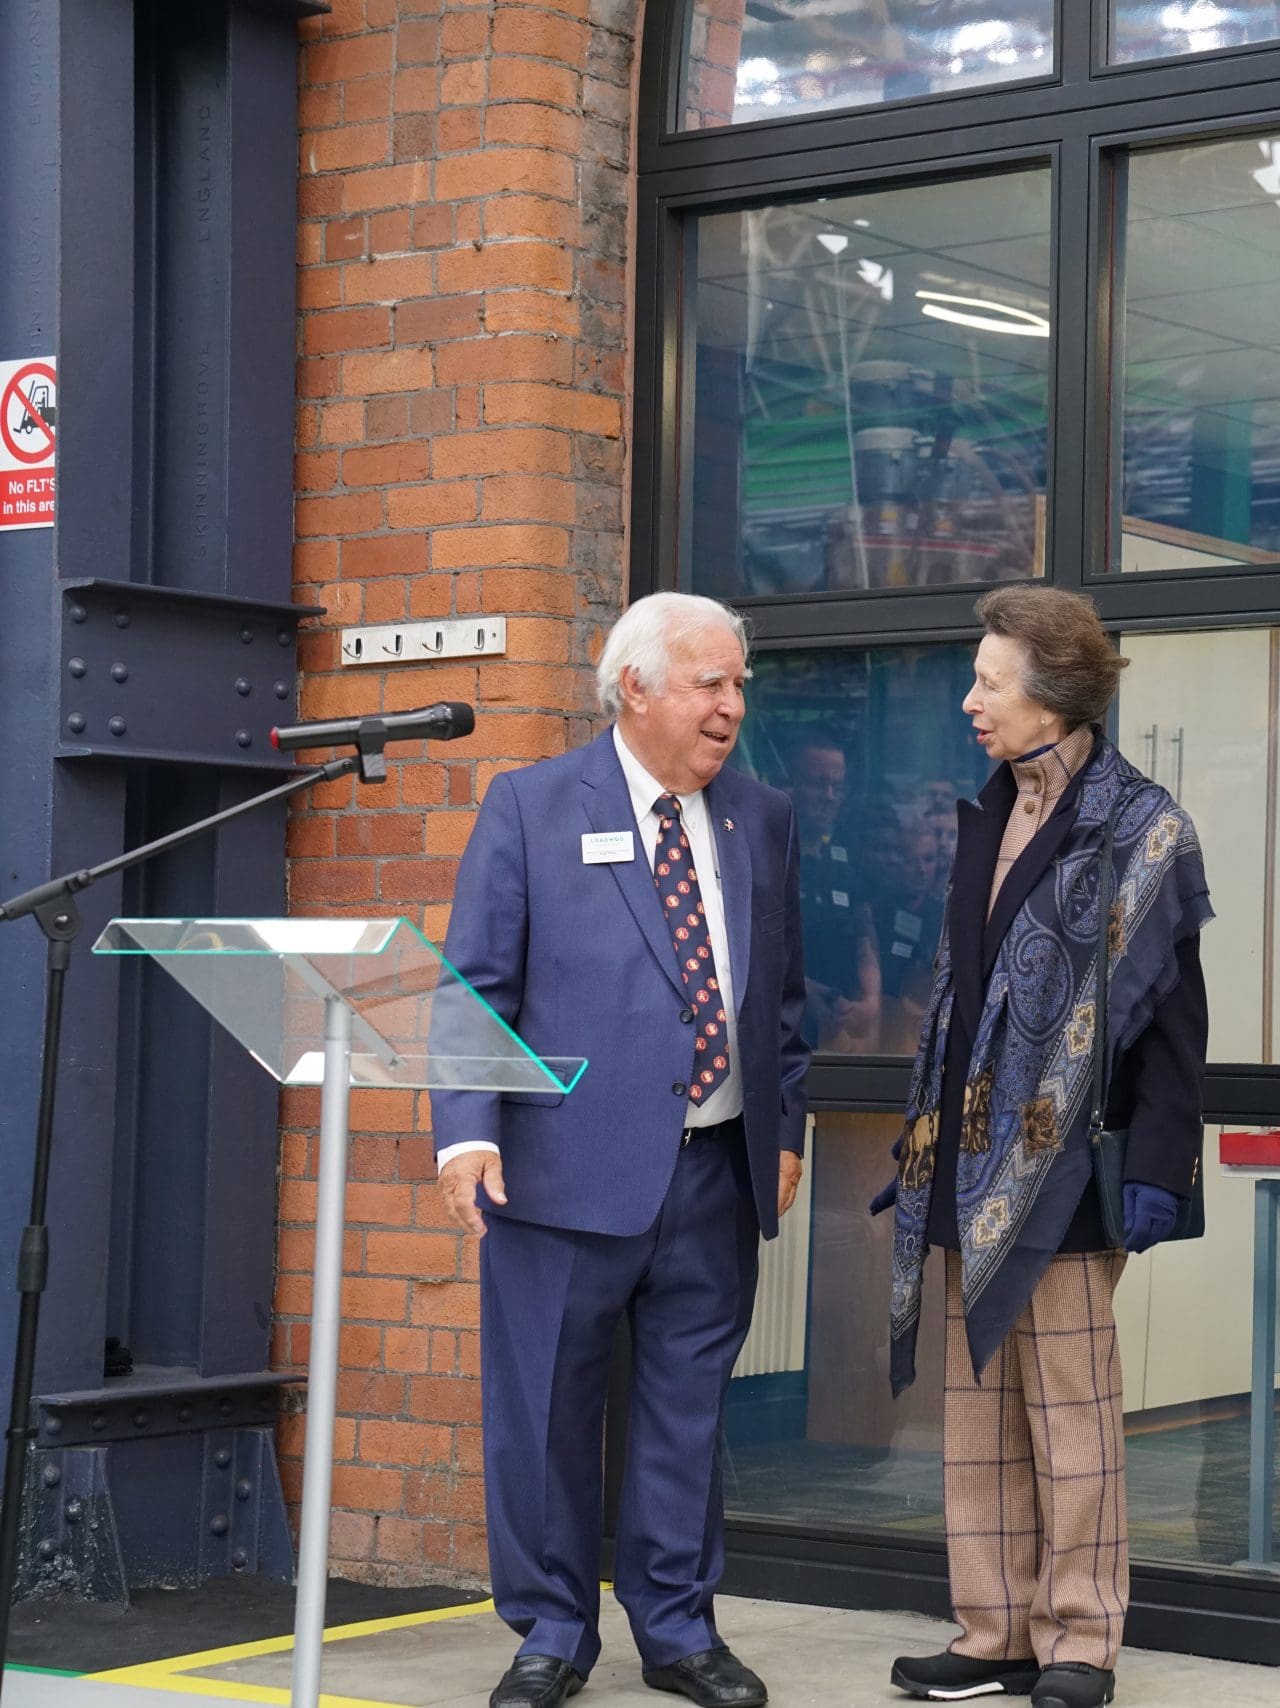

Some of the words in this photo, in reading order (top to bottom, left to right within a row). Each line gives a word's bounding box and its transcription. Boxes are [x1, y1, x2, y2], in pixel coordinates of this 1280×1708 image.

[8, 480, 25, 495] No
[3, 500, 14, 515] in
[15, 498, 36, 514] this
[38, 500, 55, 512] are
